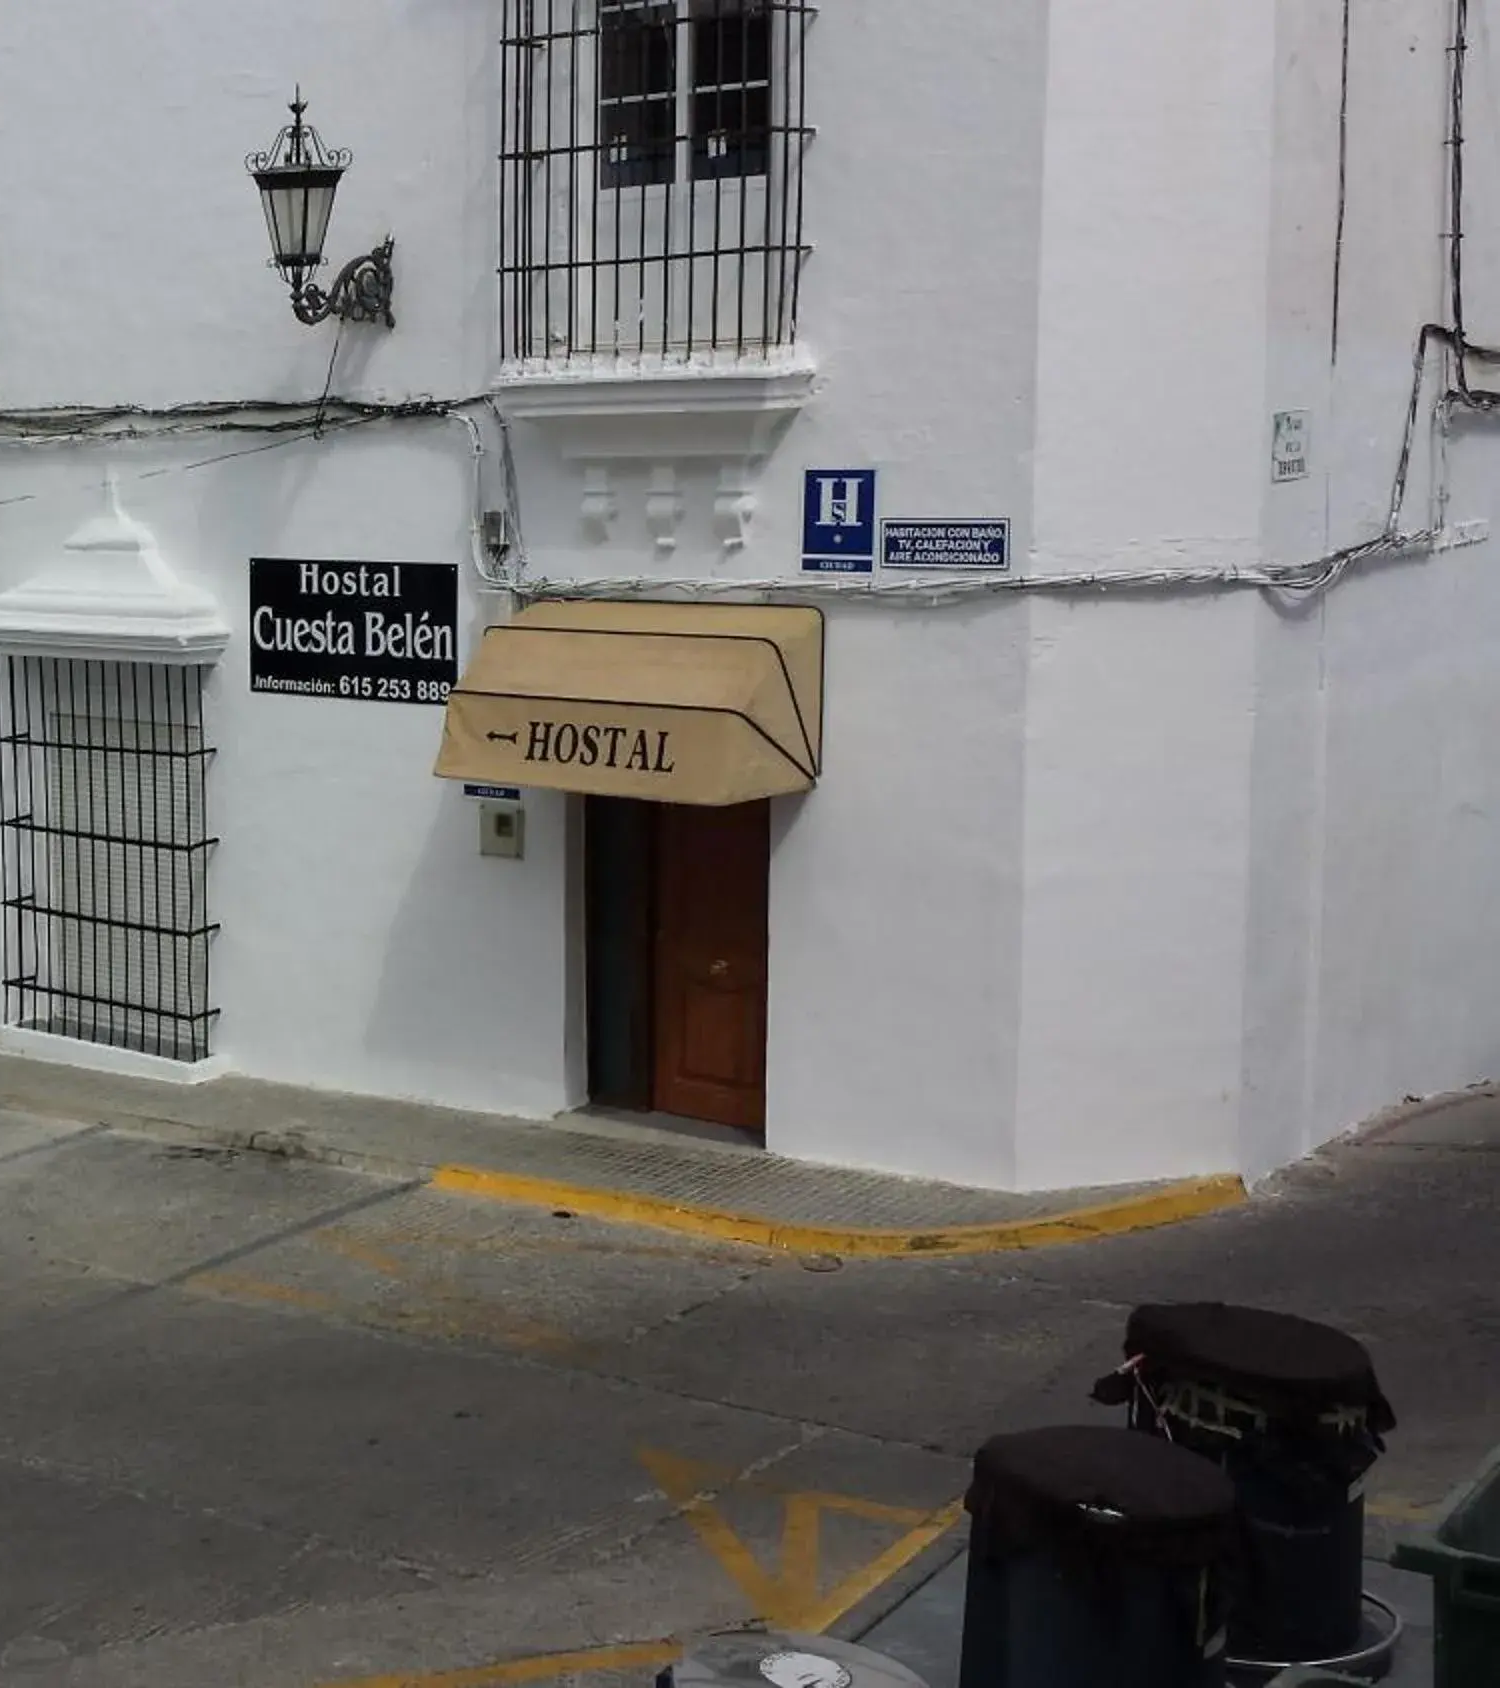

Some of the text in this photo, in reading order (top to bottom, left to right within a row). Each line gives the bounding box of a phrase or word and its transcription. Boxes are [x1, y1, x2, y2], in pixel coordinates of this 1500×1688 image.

[947, 527, 970, 538] CON
[981, 540, 992, 551] Y
[889, 551, 1000, 563] AIRE ACONDICIONADO
[299, 563, 402, 597] Hostal
[253, 605, 454, 660] Cuesta Belén
[253, 674, 450, 701] Información: 615 253 889
[524, 721, 676, 773] HOSTAL
